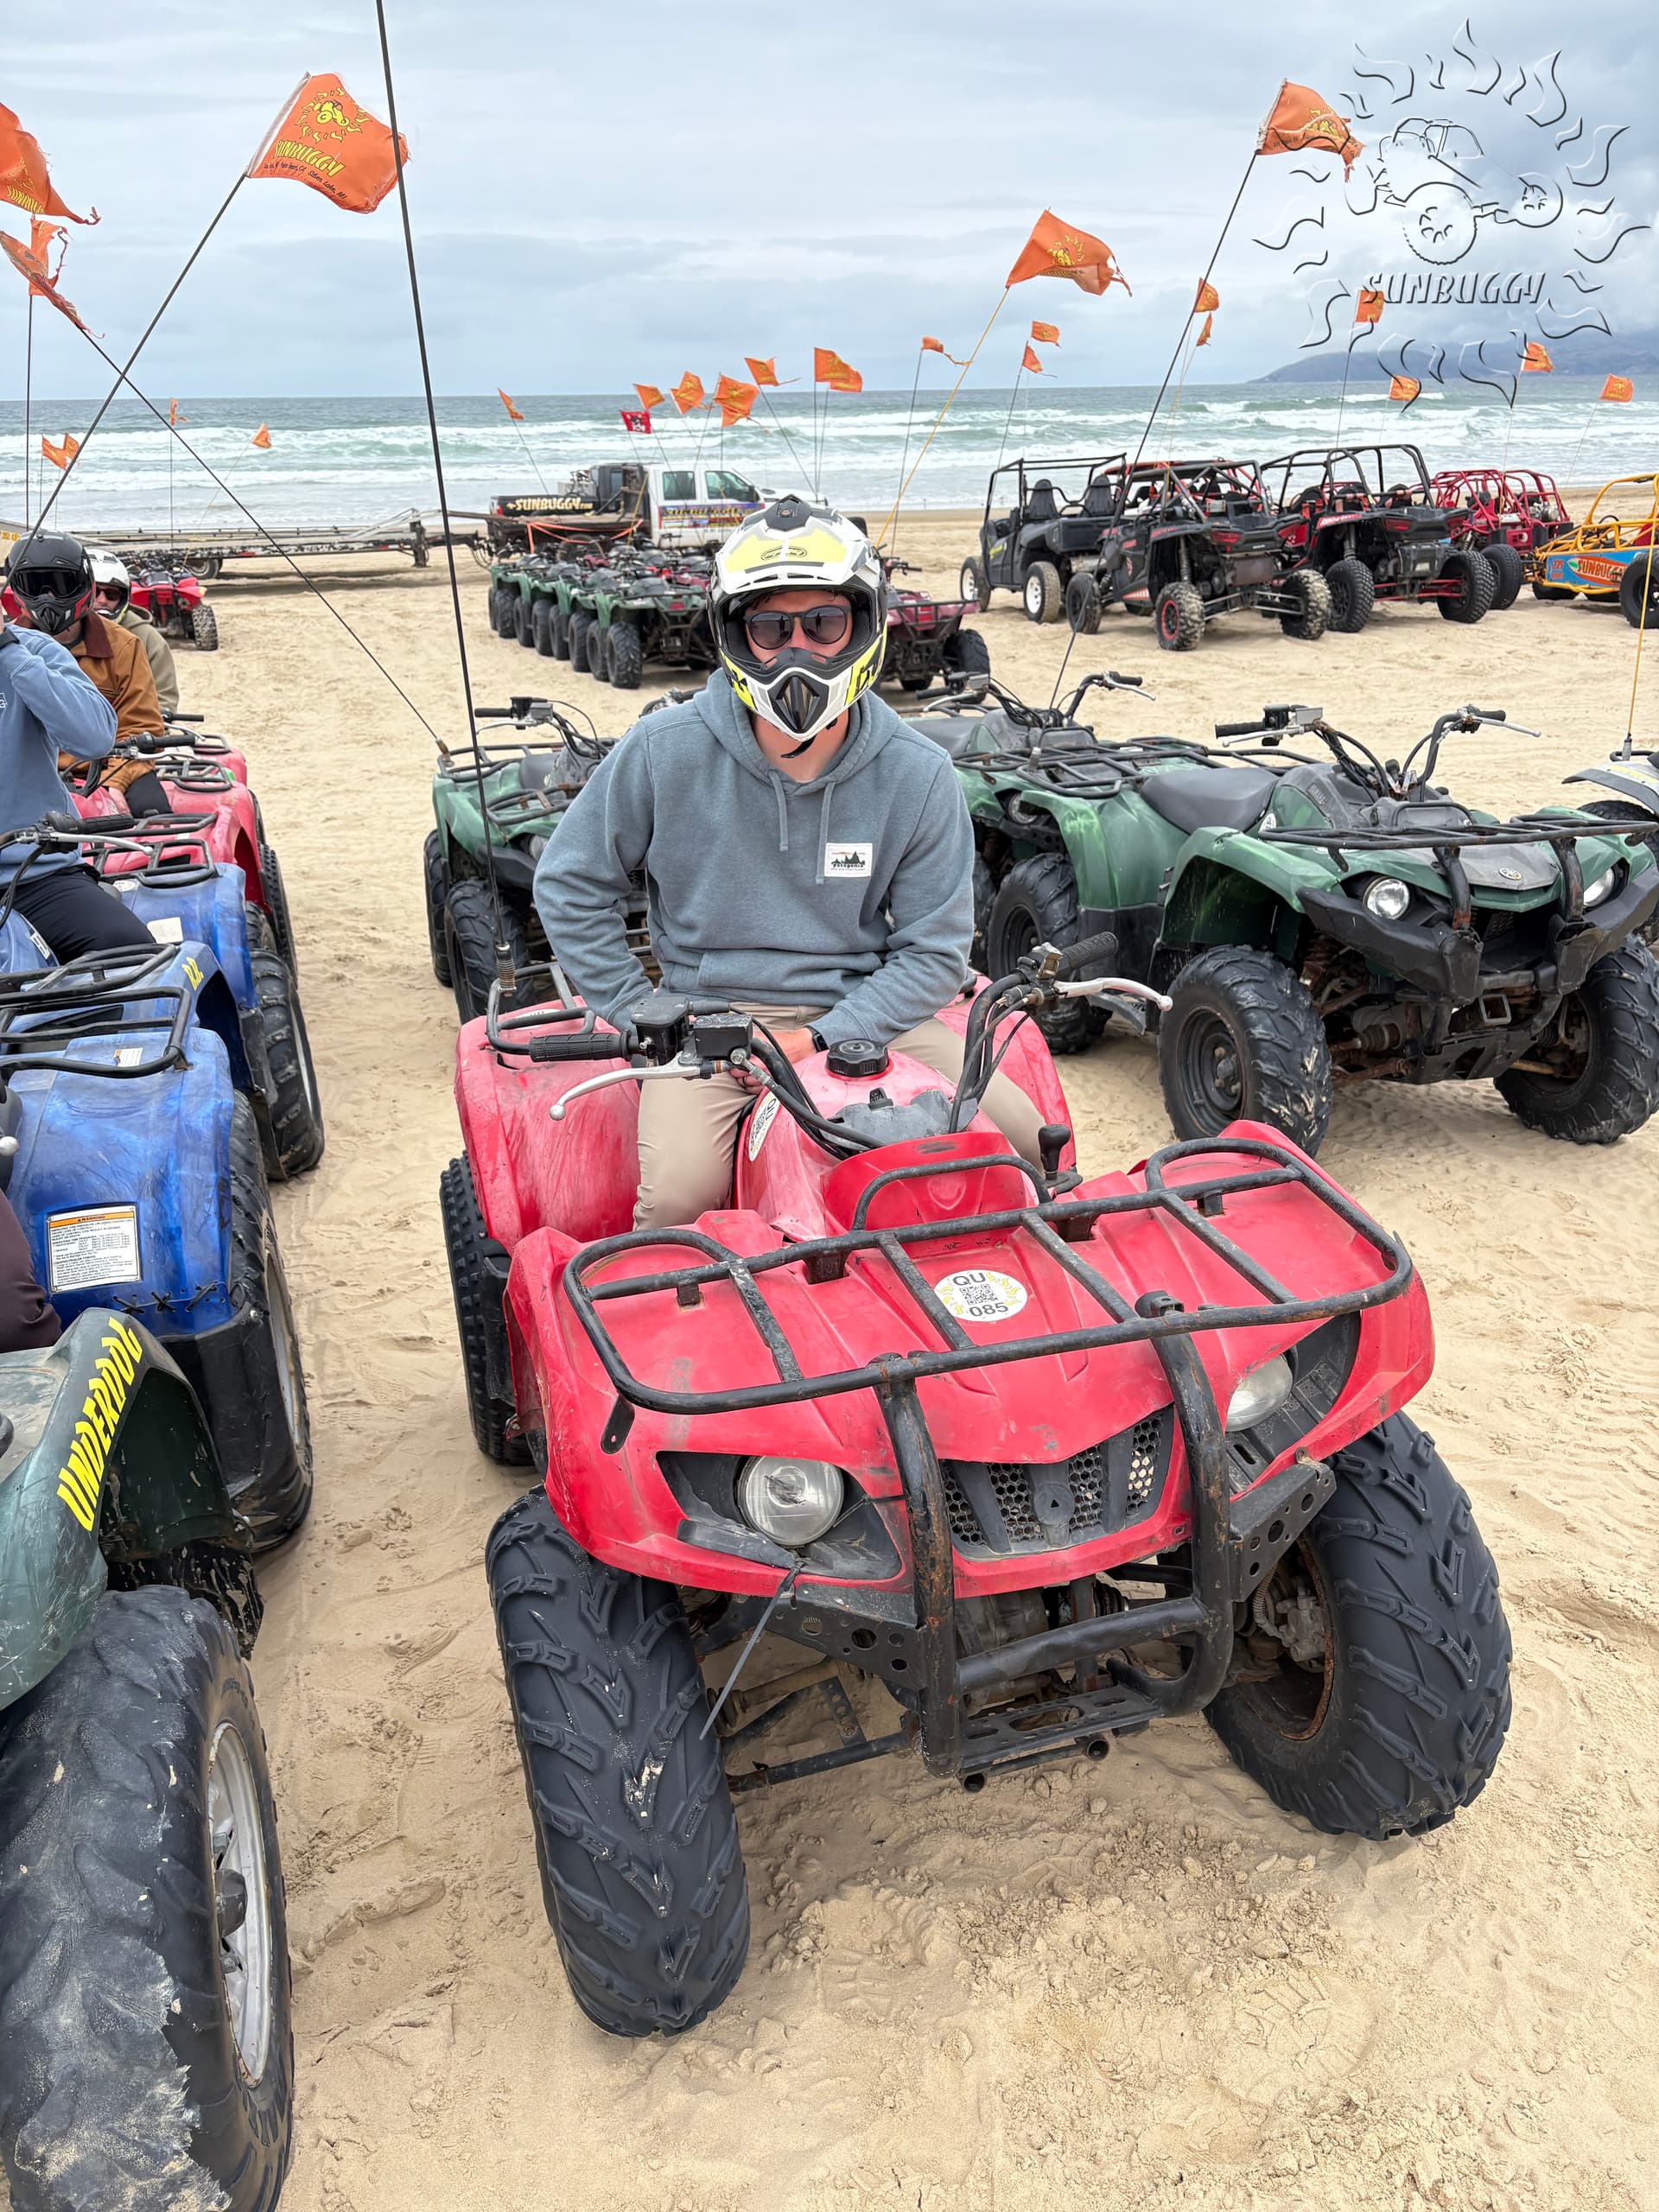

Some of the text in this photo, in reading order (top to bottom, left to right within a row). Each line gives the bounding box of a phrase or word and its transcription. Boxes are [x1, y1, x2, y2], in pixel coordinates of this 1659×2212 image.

[952, 1272, 987, 1287] QU
[969, 1301, 1009, 1317] 085
[56, 1316, 143, 1532] UNDERDOG
